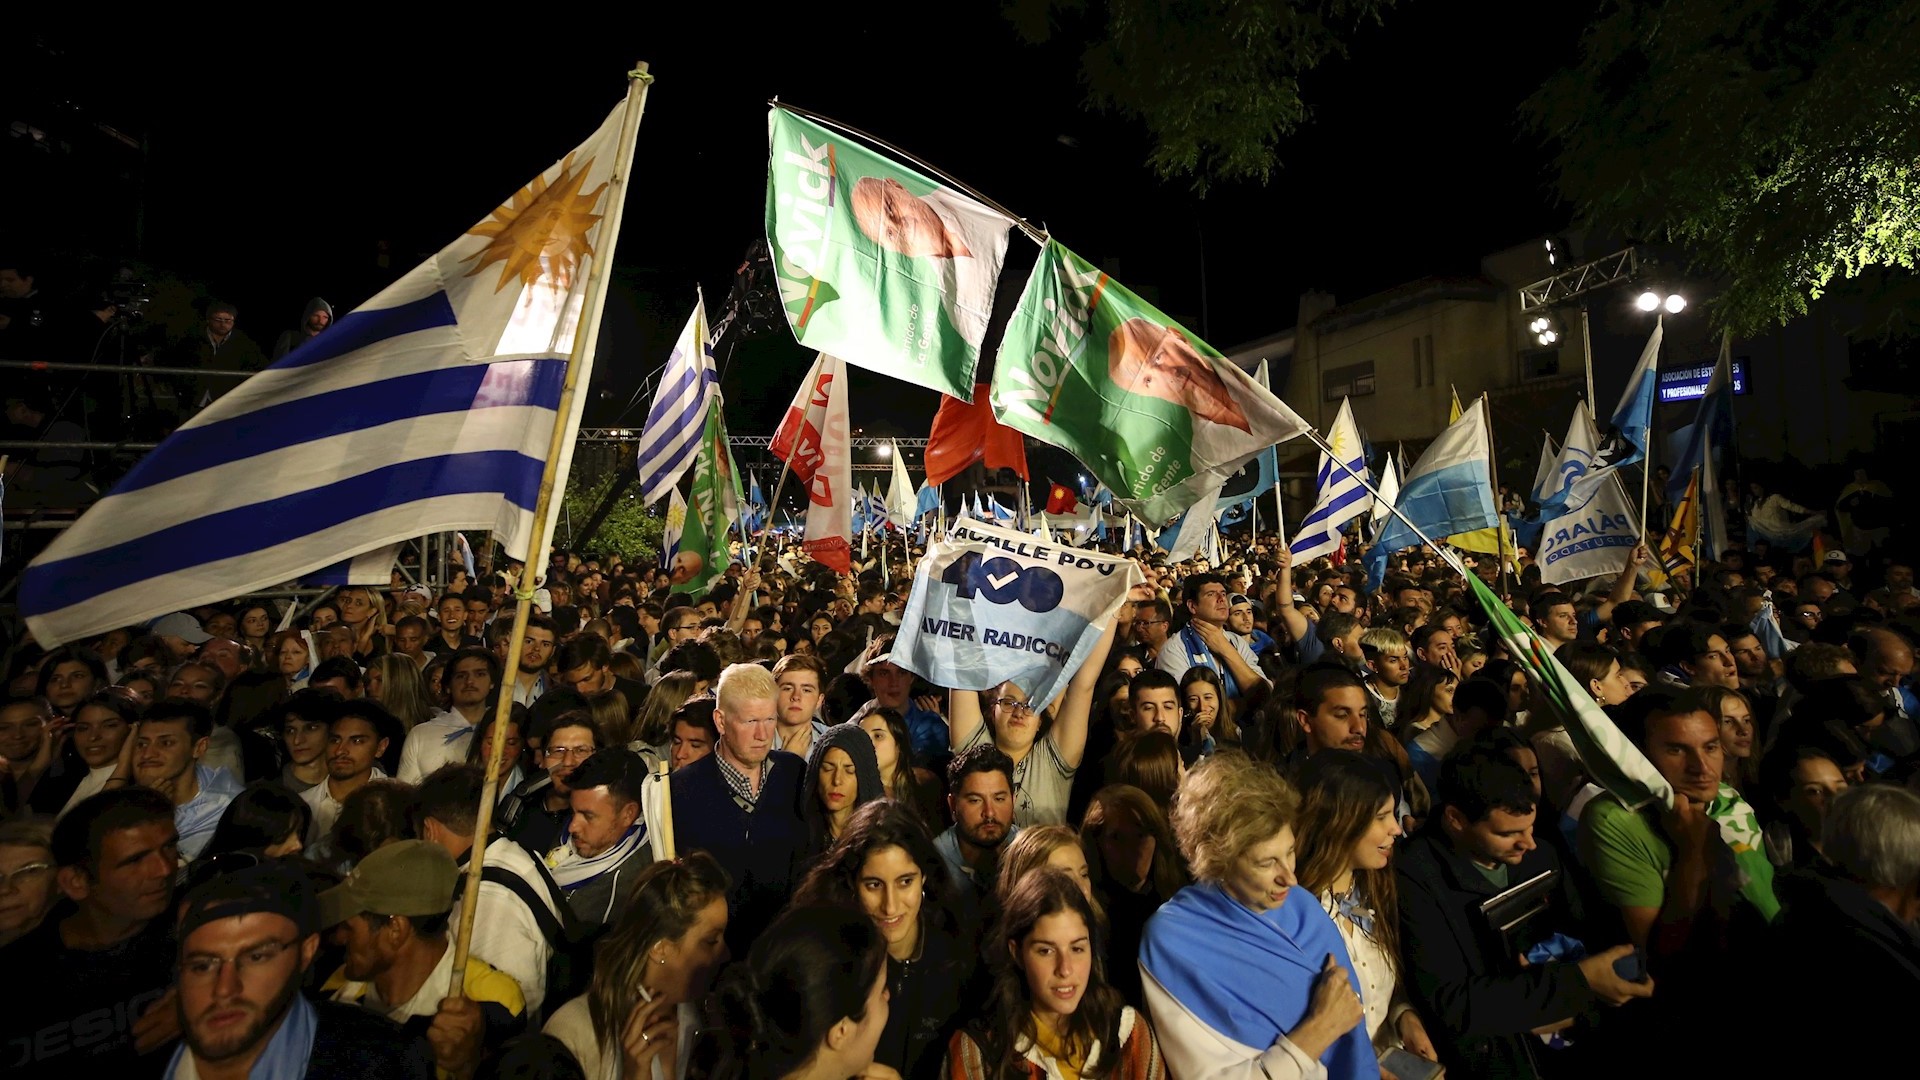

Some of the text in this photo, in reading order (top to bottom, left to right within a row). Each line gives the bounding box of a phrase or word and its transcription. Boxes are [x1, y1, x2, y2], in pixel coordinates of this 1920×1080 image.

[907, 303, 919, 320] de
[914, 310, 936, 368] La Gente
[1693, 368, 1701, 378] DE
[1662, 388, 1667, 398] Y
[1149, 446, 1166, 462] de
[1151, 460, 1181, 495] Gente
[954, 527, 1116, 576] ACALLE POU
[942, 551, 1064, 613] 400
[922, 616, 975, 642] AVIER
